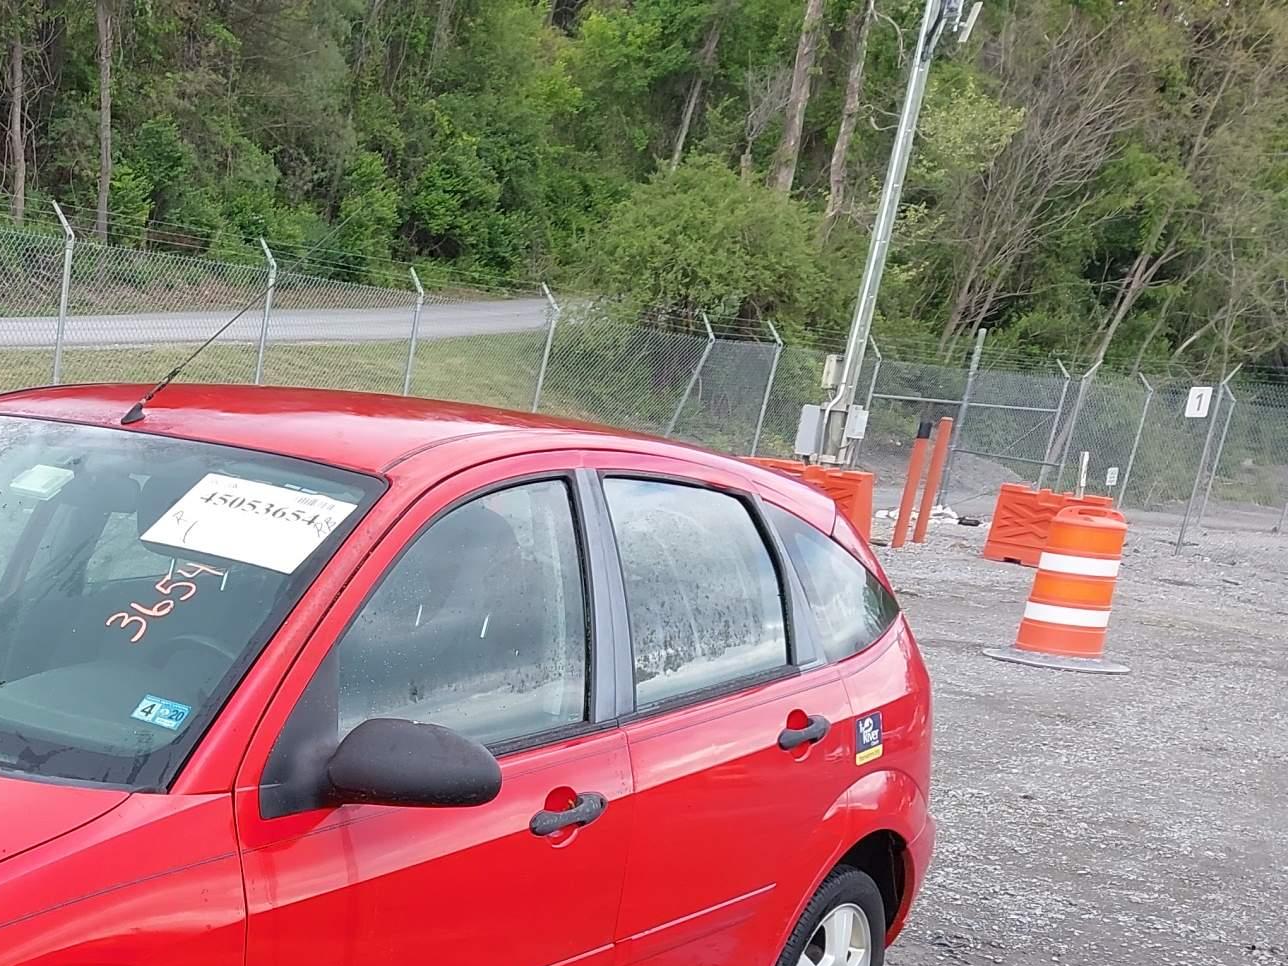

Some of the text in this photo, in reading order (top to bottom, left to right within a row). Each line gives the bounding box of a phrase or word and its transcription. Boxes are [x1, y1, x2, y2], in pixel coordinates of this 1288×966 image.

[1196, 392, 1204, 411] 1
[199, 491, 320, 526] 45053654
[105, 558, 228, 642] 3654
[140, 703, 156, 717] 4
[168, 709, 185, 722] 20
